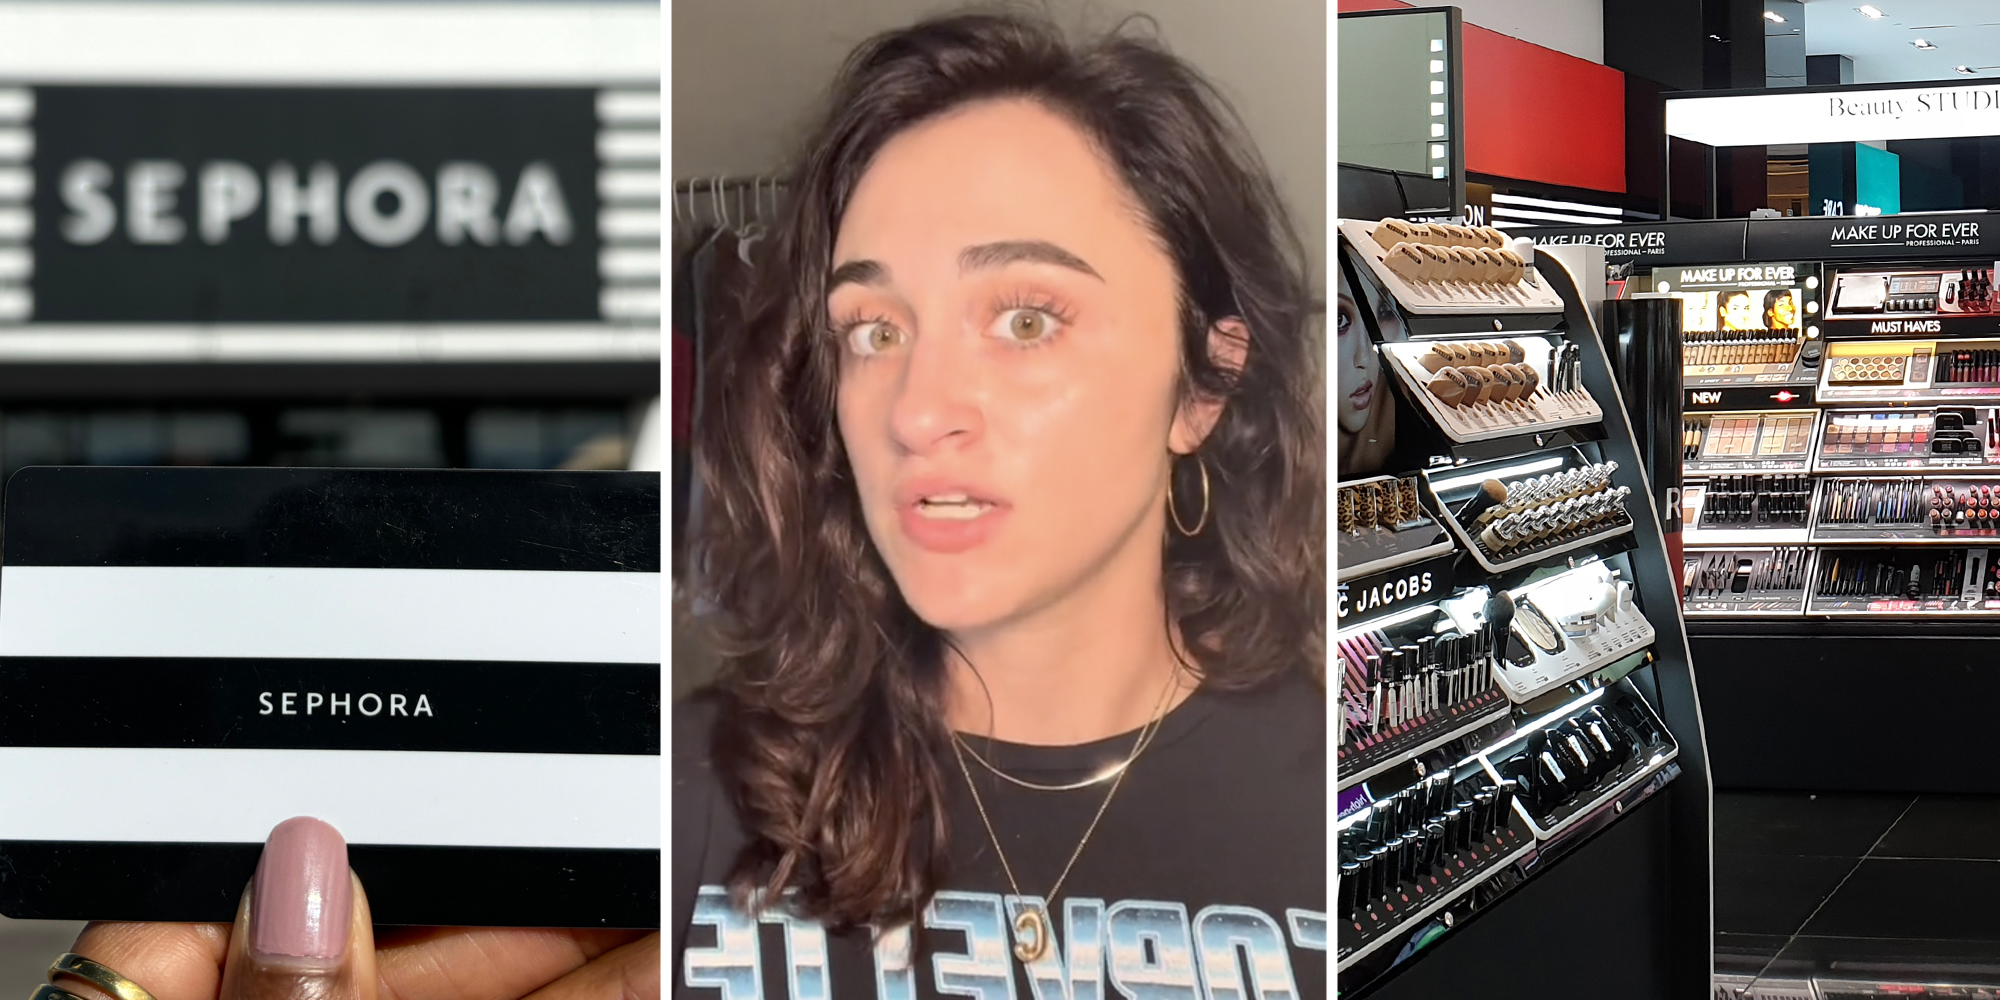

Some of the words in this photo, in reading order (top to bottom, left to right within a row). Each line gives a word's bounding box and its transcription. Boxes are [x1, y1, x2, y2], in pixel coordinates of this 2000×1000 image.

[1829, 97, 1907, 119] Beauty
[58, 158, 573, 247] SEPHORA
[1595, 233, 1625, 248] FOR
[1629, 232, 1666, 248] EVER
[1831, 225, 1878, 241] MAKE
[1882, 224, 1902, 239] UP
[1905, 223, 1938, 239] FOR
[1941, 222, 1980, 238] EVER
[1905, 239, 1955, 247] PROFESSIONAL
[1961, 238, 1980, 246] PARIS
[1680, 269, 1718, 283] MAKE
[1719, 268, 1736, 281] UP
[1737, 267, 1763, 281] FOR
[1765, 266, 1795, 280] EVER
[1871, 321, 1903, 334] MUST
[1904, 320, 1942, 333] HAVES
[1692, 391, 1722, 404] NEW
[1356, 572, 1432, 613] JACOBS
[258, 691, 434, 717] SEPHORA
